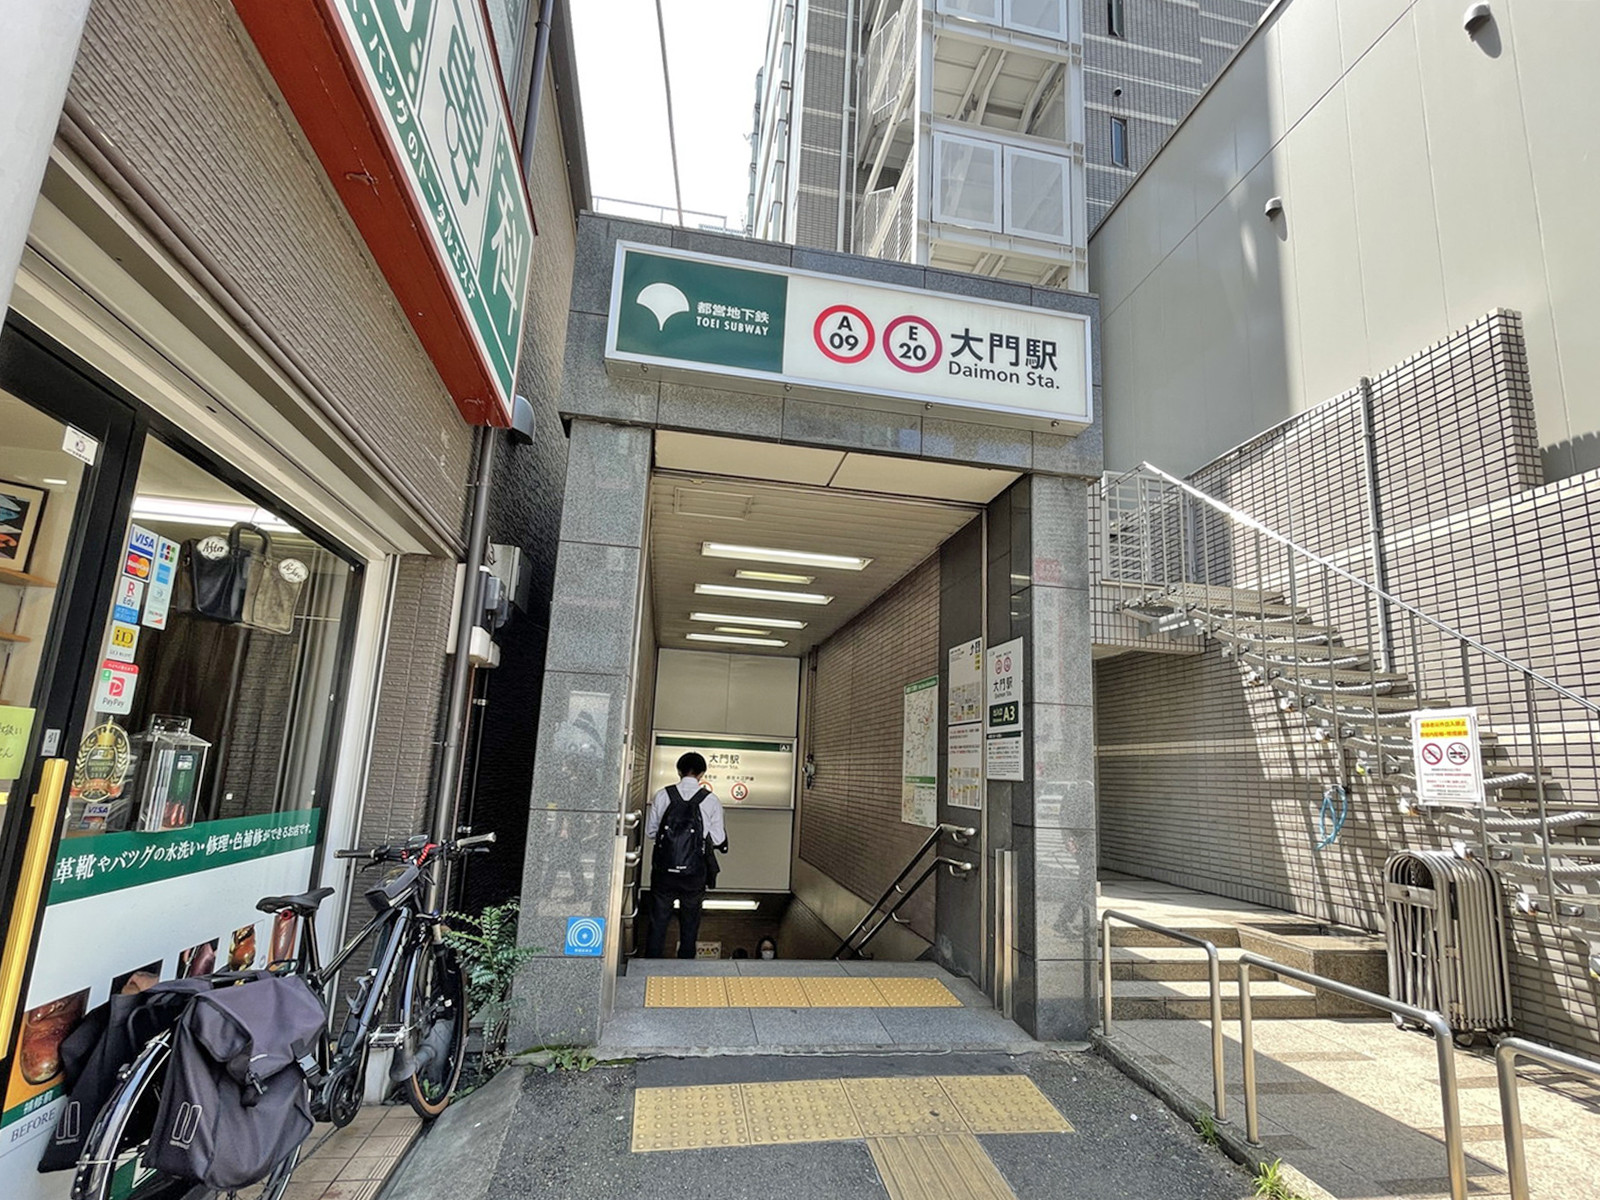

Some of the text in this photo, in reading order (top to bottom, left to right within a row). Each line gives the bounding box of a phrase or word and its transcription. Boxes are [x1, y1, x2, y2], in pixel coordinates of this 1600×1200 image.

[697, 301, 769, 324] 都営地下鉄
[696, 316, 769, 336] TOEI SUBWAY
[837, 315, 853, 332] A
[829, 332, 859, 351] 09
[908, 325, 919, 342] E
[898, 342, 927, 361] 20
[950, 327, 1058, 372] 大門駅
[949, 360, 1060, 389] Daimon Sta.
[134, 531, 155, 550] VISA
[202, 540, 224, 553] After
[115, 629, 134, 645] iD
[993, 676, 1014, 693] 大門駅
[102, 697, 124, 708] PayPay
[1003, 705, 1016, 722] A3
[709, 754, 740, 765] 大門駅
[88, 806, 108, 814] VISA
[11, 1107, 56, 1143] BEFORE
